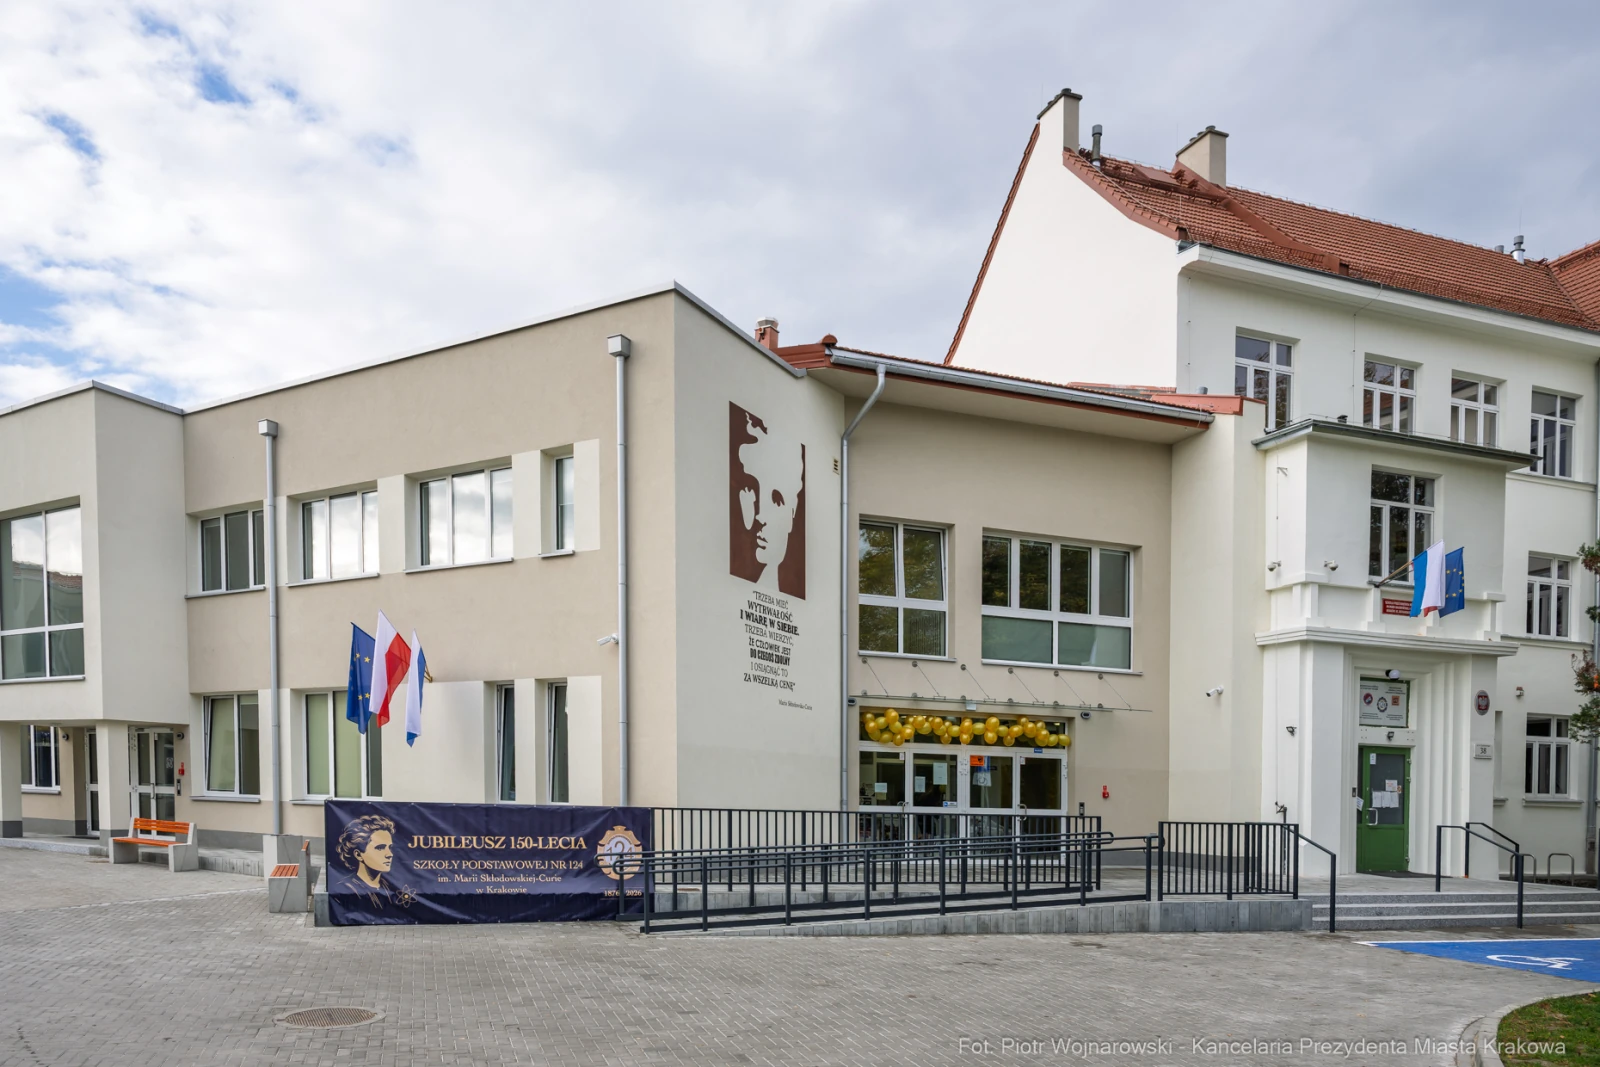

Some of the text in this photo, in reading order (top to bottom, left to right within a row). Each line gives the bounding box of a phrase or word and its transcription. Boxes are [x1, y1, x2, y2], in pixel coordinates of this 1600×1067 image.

[740, 608, 743, 620] I
[745, 610, 768, 628] WIARĘ
[769, 618, 775, 628] W
[745, 623, 767, 638] TRZEBA
[744, 673, 751, 682] ZA
[752, 674, 778, 689] WSZELKĄ
[408, 835, 587, 850] JUBILEUSZ 150-LECIA
[413, 860, 584, 870] SZKOŁY PODSTAWOWEJ NR 124
[438, 874, 562, 884] im. Marii Skłodowskiej-Curie
[486, 885, 527, 894] Krakowie
